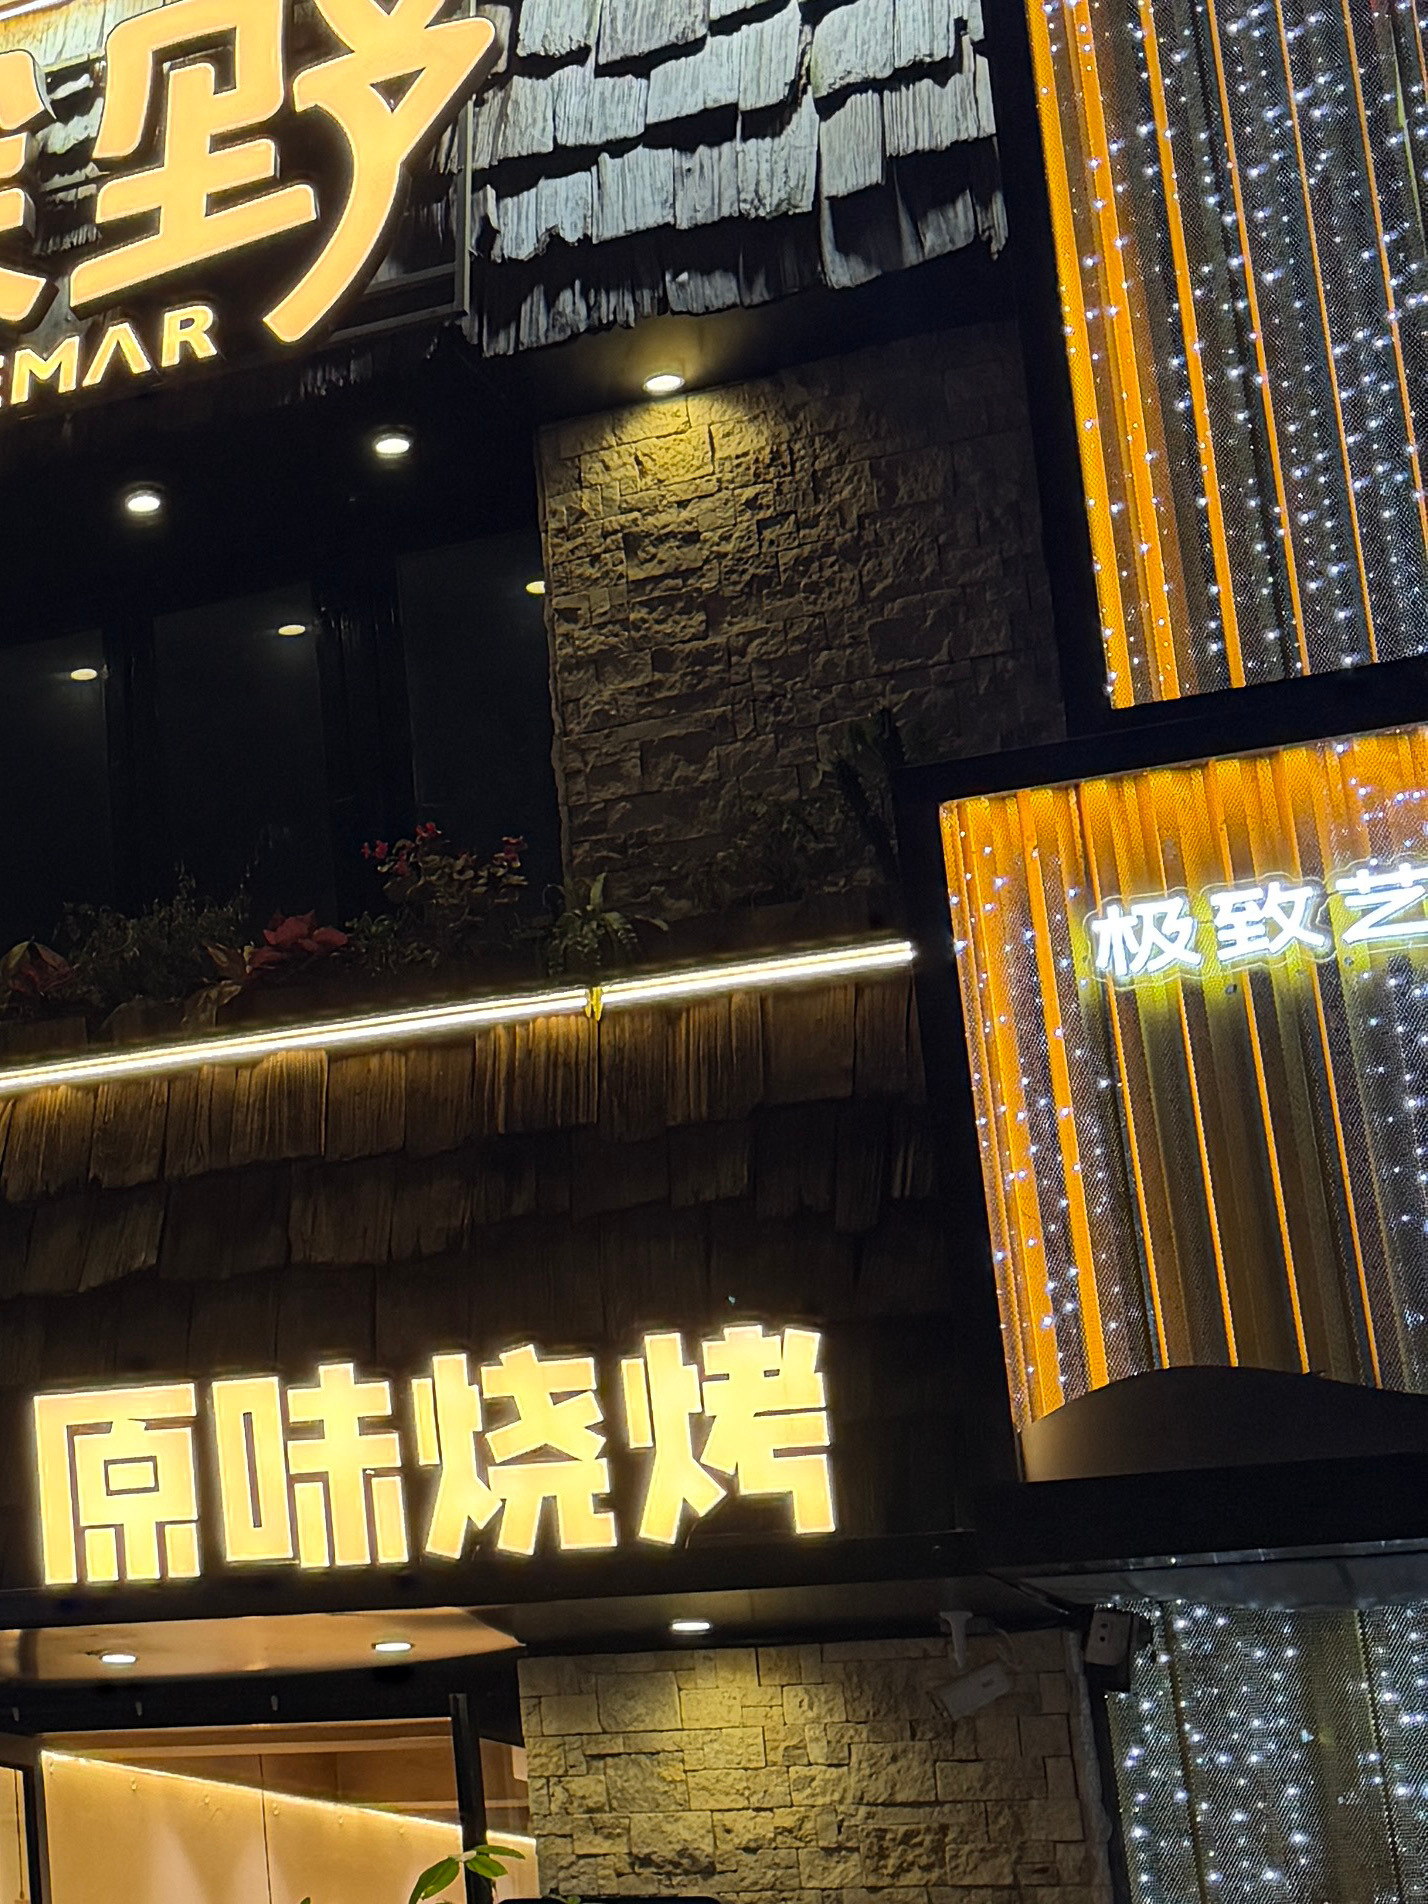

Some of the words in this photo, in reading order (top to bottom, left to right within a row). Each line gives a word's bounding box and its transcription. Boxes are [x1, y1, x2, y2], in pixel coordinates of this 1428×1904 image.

[1091, 862, 1428, 978] 极致艺
[32, 1324, 837, 1585] 原味烧烤
